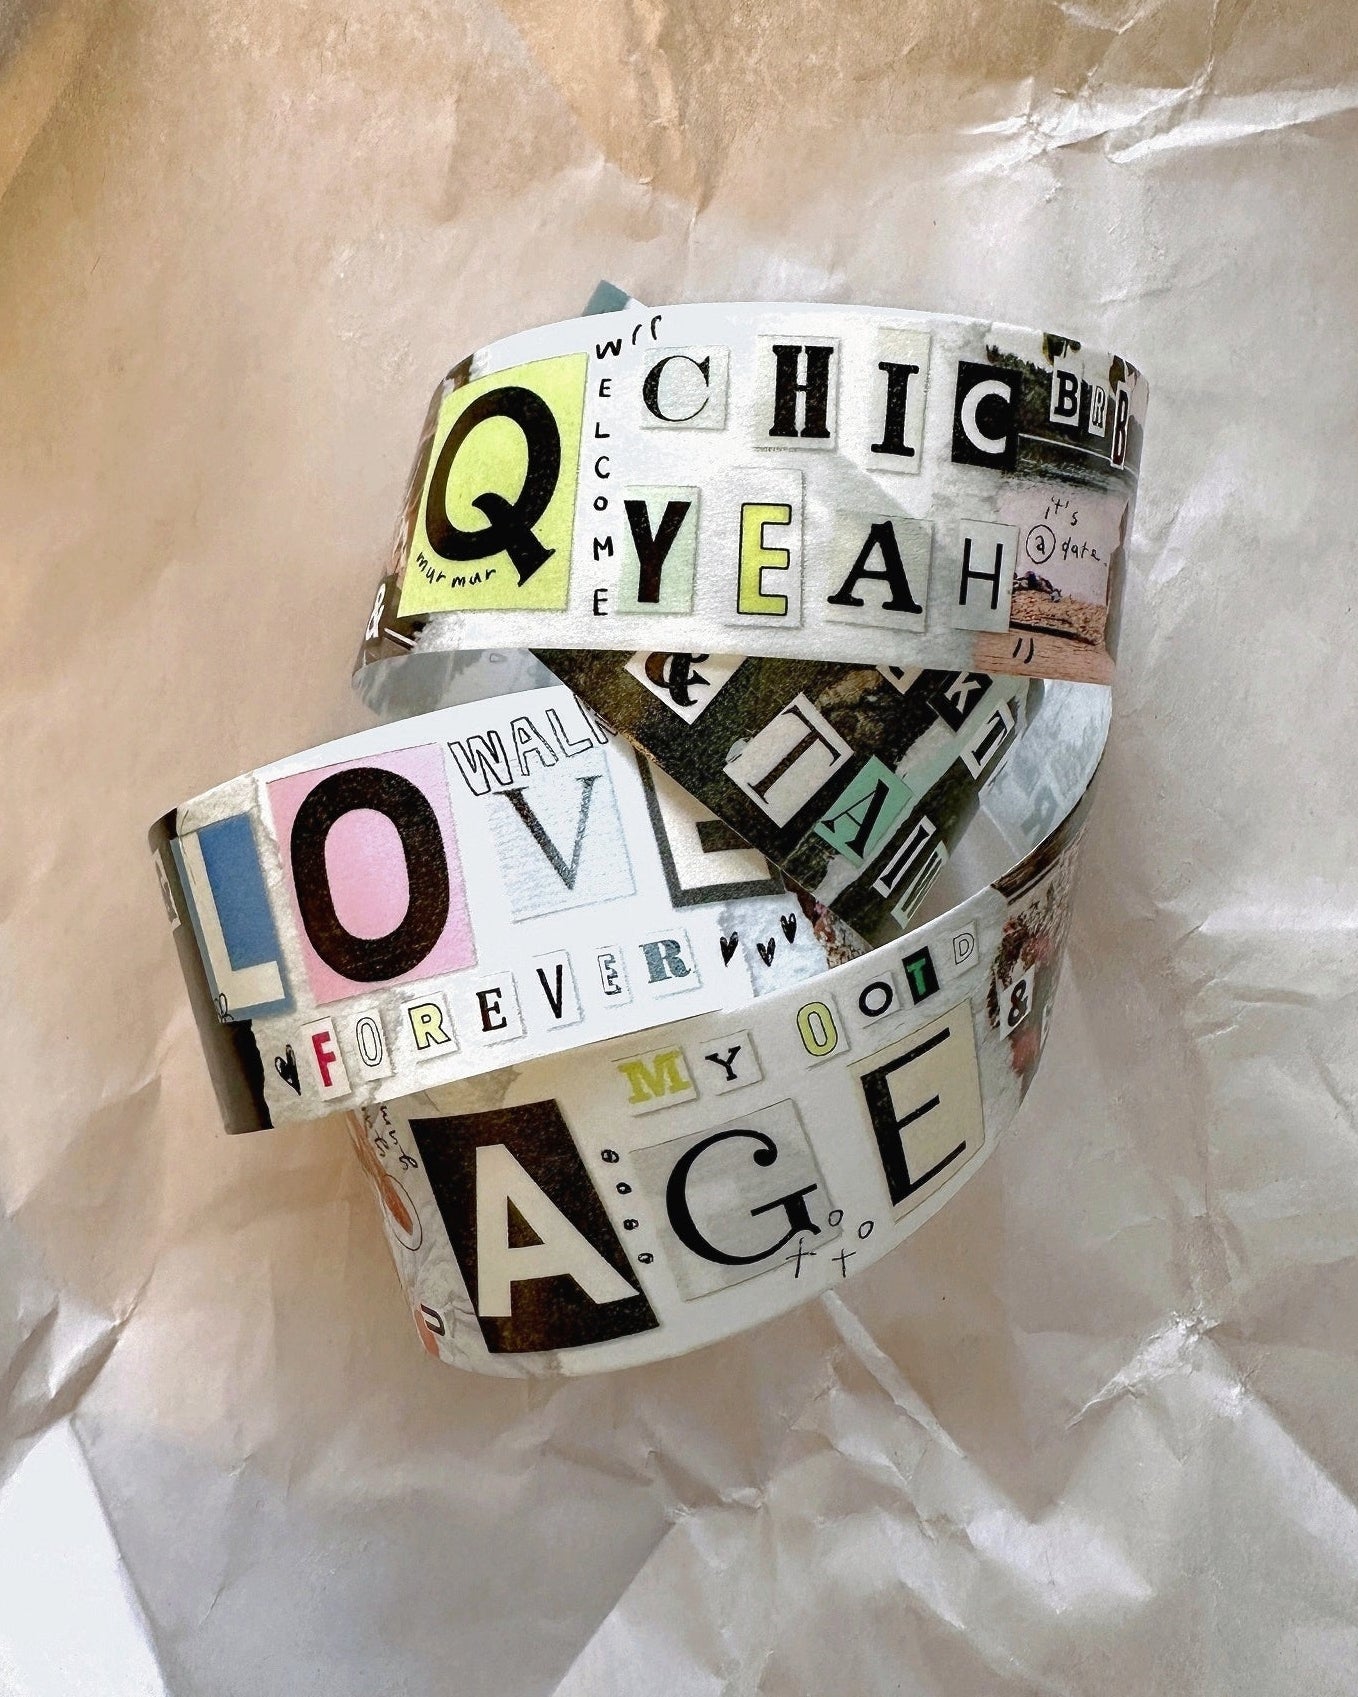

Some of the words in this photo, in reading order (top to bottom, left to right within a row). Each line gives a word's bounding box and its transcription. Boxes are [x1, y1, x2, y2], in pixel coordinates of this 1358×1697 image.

[424, 386, 561, 587] Q
[593, 338, 624, 616] WELCOME
[641, 344, 1013, 458] CHIC
[623, 500, 1003, 617] YEAH
[312, 938, 692, 1088] FOREVER
[617, 1045, 742, 1104] MY
[796, 932, 975, 1058] OOTD
[475, 1027, 975, 1318] AGE
